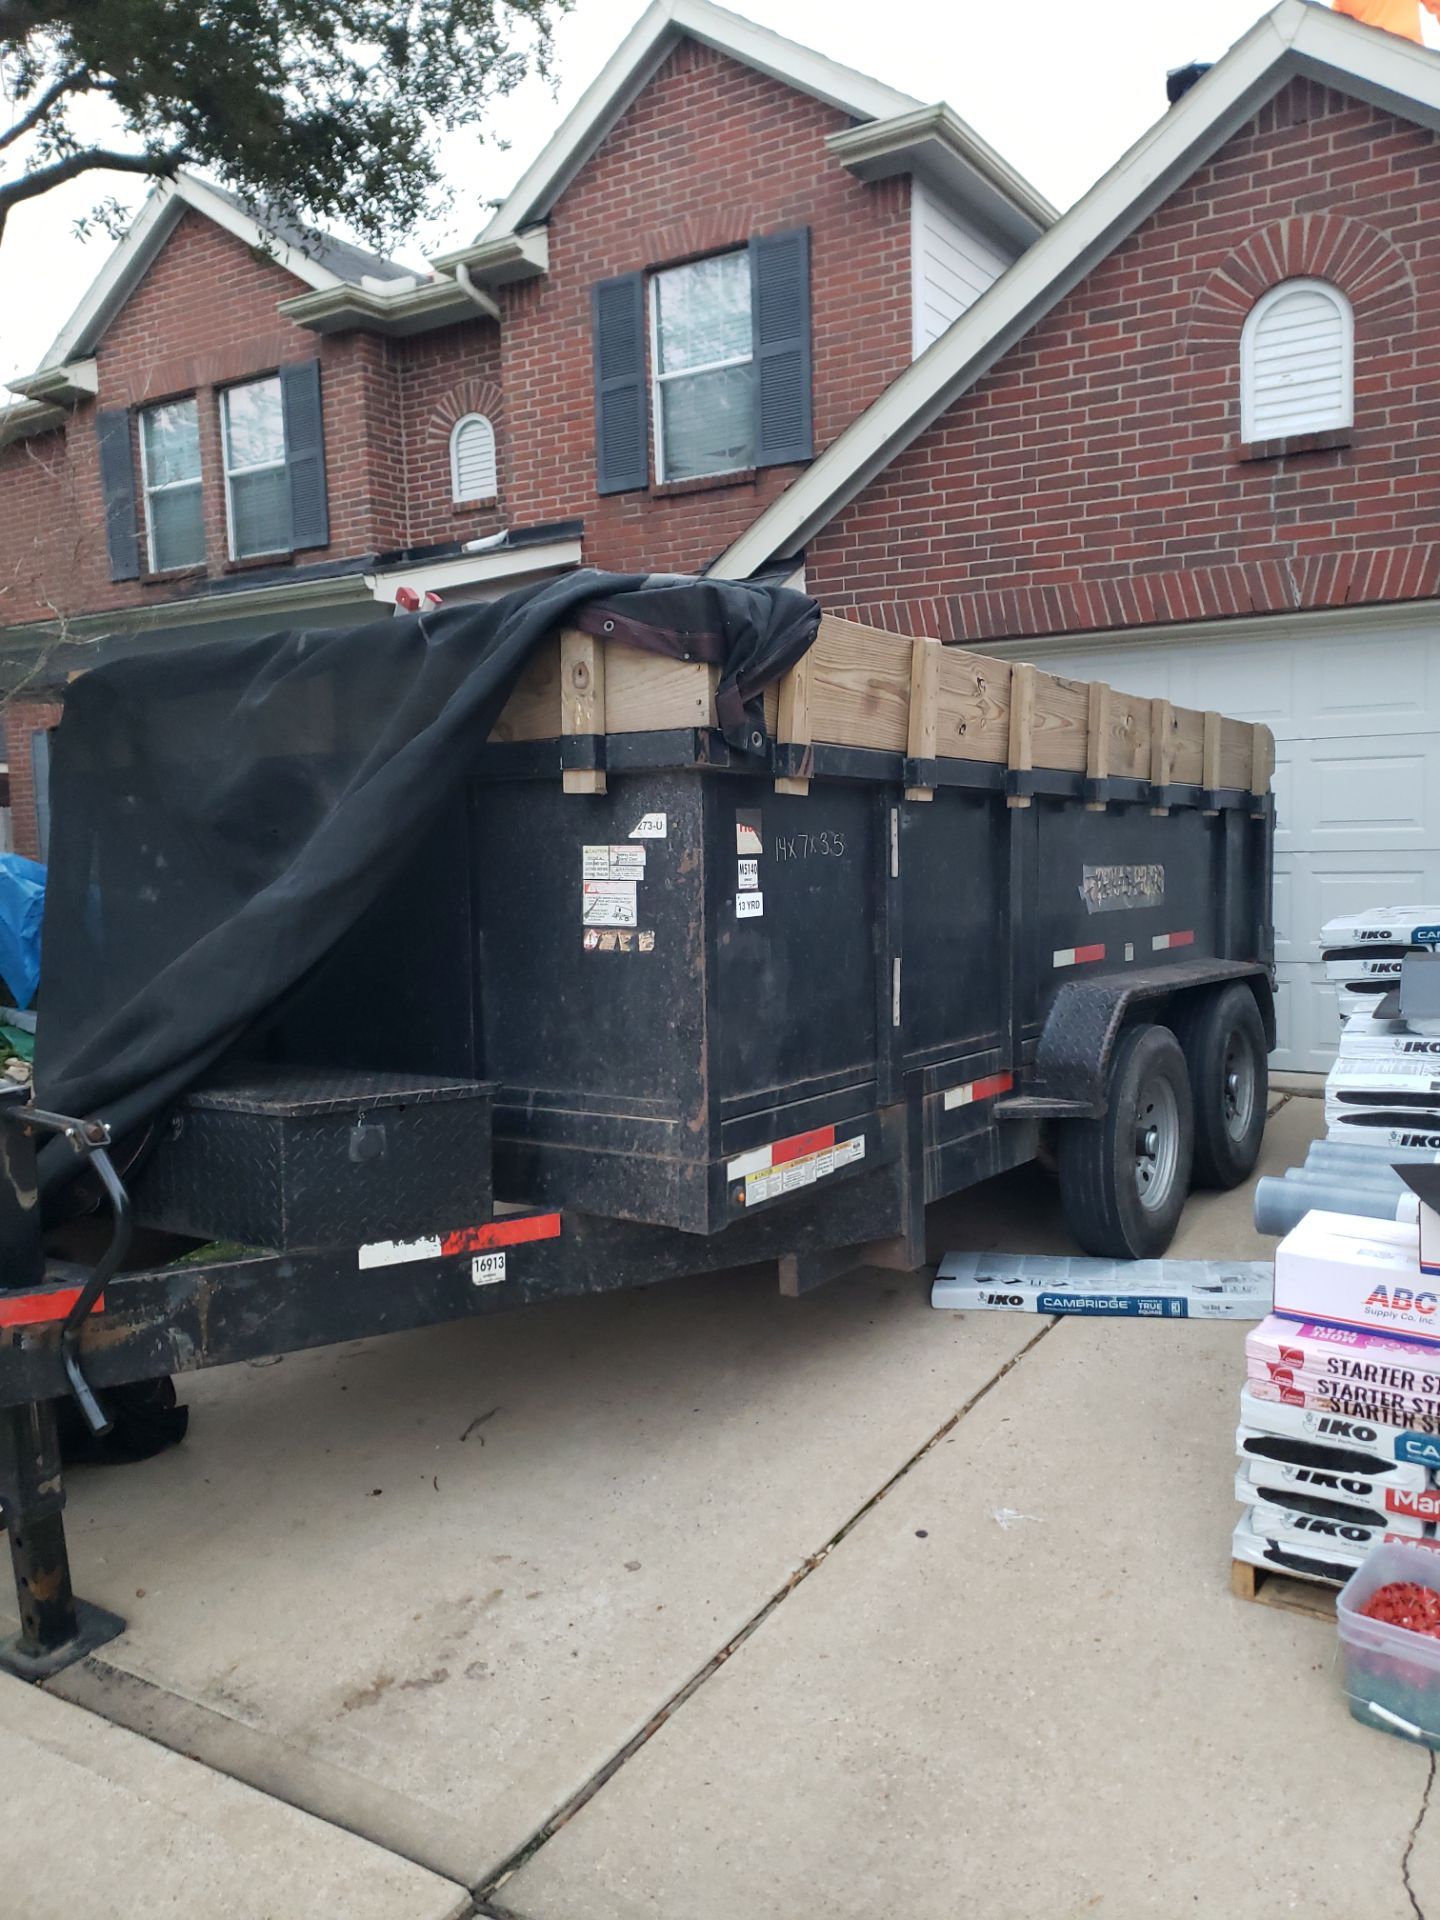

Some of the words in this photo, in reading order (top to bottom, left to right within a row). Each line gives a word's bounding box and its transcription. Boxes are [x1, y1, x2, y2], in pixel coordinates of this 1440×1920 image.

[738, 902, 746, 911] 13
[747, 900, 761, 911] YRD
[1360, 930, 1393, 940] IKO
[475, 1256, 504, 1272] 16913
[987, 1294, 1025, 1306] IKO
[1043, 1297, 1129, 1310] CAMBRIDGE
[1137, 1302, 1163, 1310] TRUE
[1364, 1285, 1438, 1315] ABC
[1364, 1306, 1399, 1319] Supply
[1418, 1316, 1436, 1326] Inc.
[1327, 1357, 1415, 1391] STARTER
[1317, 1379, 1405, 1409] STARTER
[1329, 1397, 1415, 1429] STARTER
[1318, 1417, 1378, 1442] IKO
[1295, 1469, 1373, 1495] IKO
[1293, 1516, 1372, 1541] IKO
